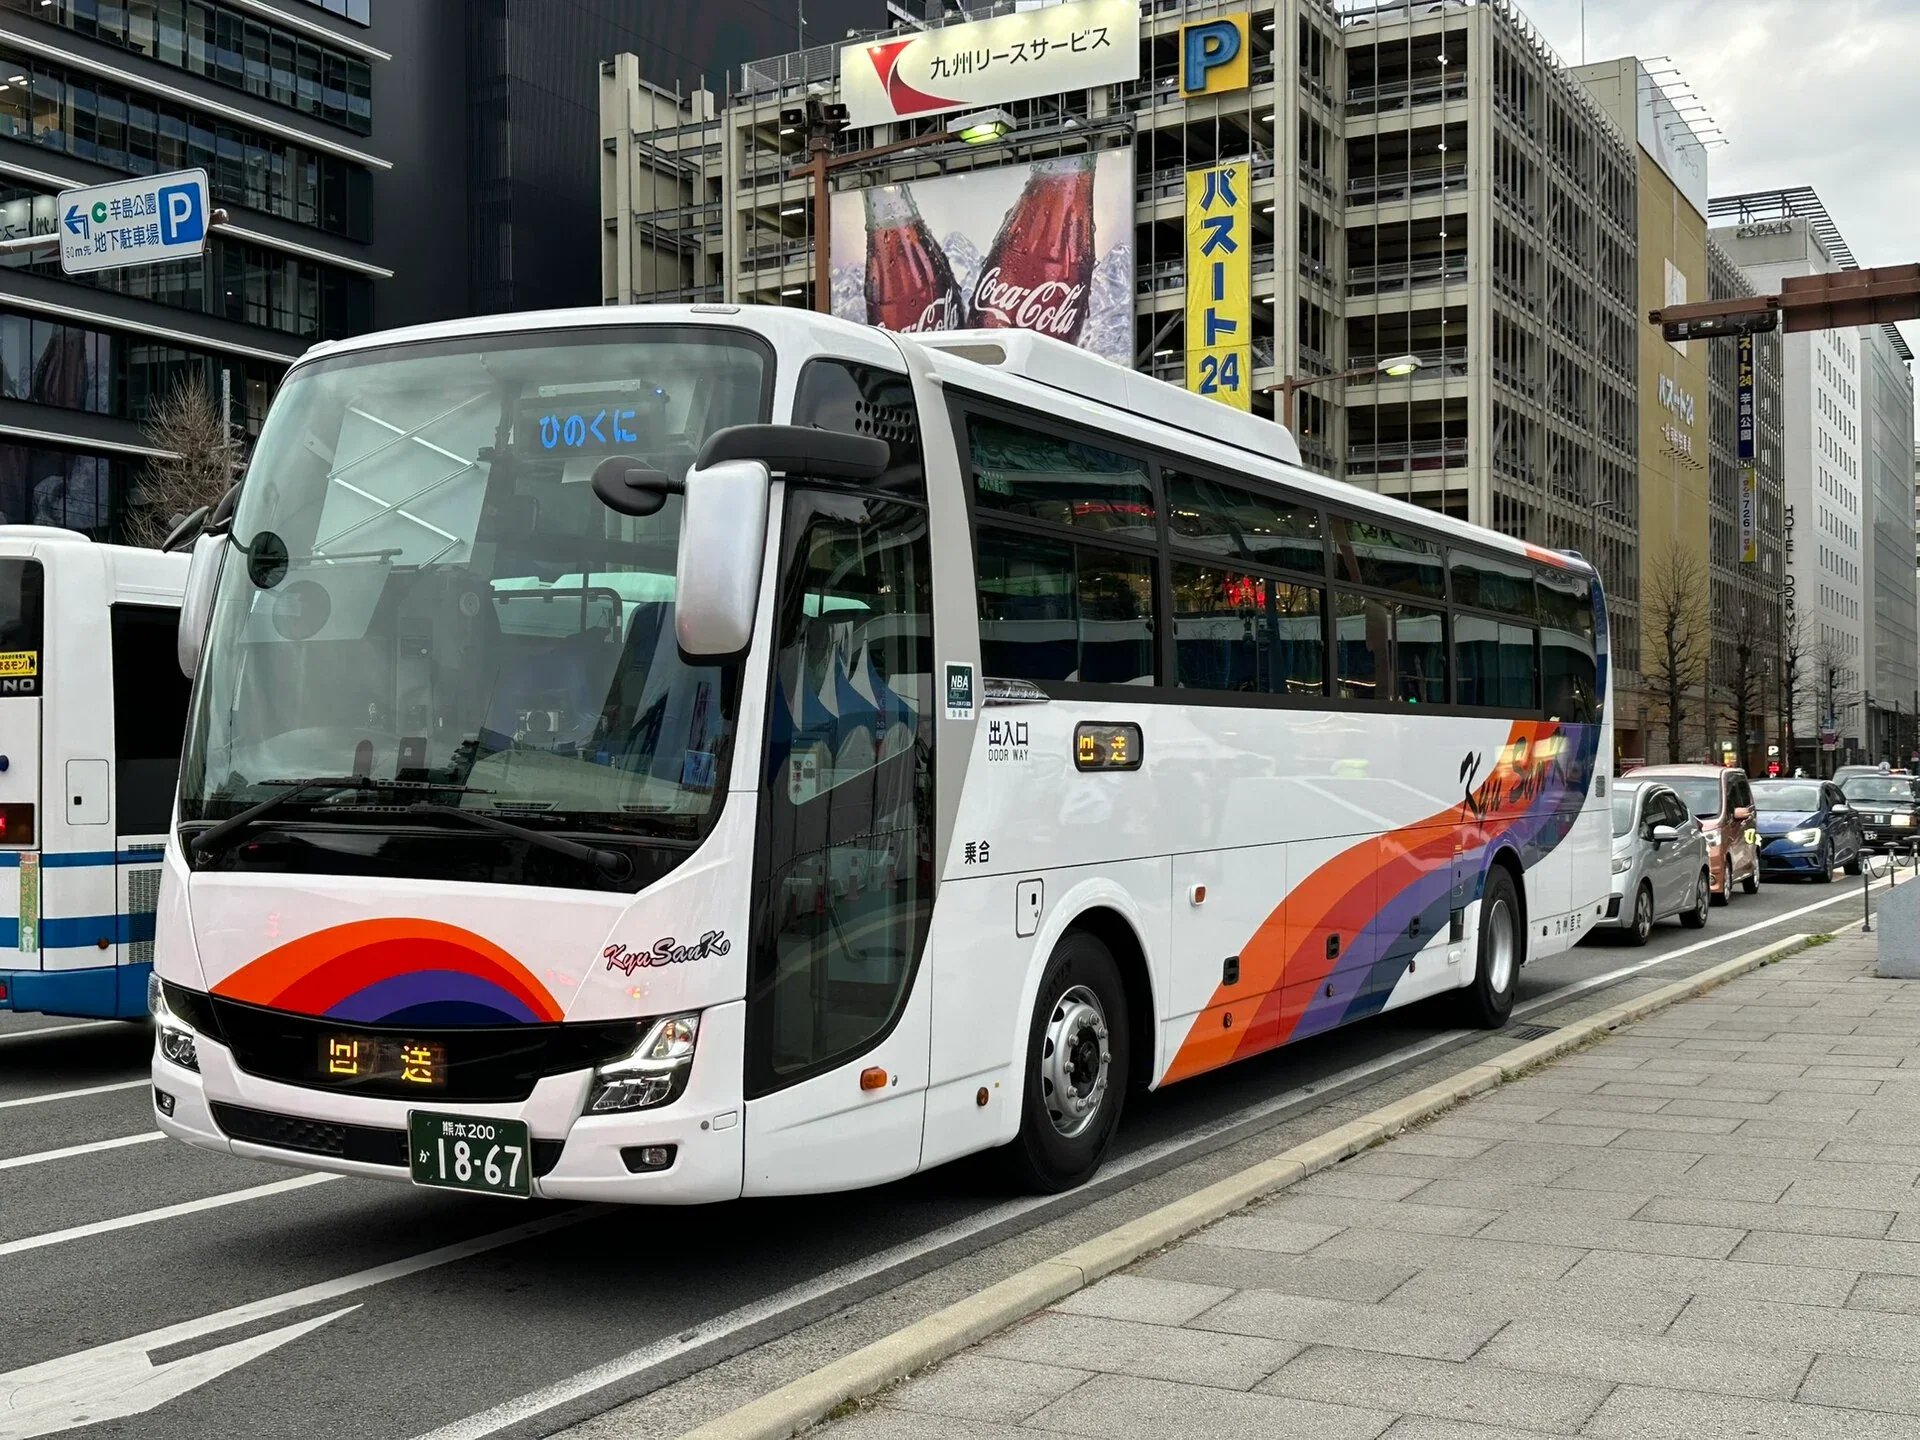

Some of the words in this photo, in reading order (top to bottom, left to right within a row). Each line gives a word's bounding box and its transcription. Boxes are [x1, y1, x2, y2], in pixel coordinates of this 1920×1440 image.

[930, 27, 1111, 80] 九州リースサービス
[1184, 21, 1241, 93] P
[110, 192, 157, 221] 辛島公園
[168, 192, 192, 238] P
[94, 223, 160, 254] 地下駐車場
[975, 267, 1085, 334] Coca-Cola
[1199, 168, 1240, 396] パスート24
[1739, 334, 1752, 388] スート24
[539, 409, 637, 449] ひのくに
[1784, 504, 1794, 564] HOTEL
[0, 679, 35, 691] NO
[950, 675, 969, 689] NBA
[988, 720, 1029, 747] 出入口
[988, 749, 1009, 761] DOOR
[1013, 749, 1029, 761] WAY
[965, 840, 990, 864] 乗合
[603, 930, 731, 976] KyuSanKo
[442, 1120, 495, 1140] 熊本200
[419, 1149, 431, 1164] か
[437, 1137, 522, 1188] 18-67
